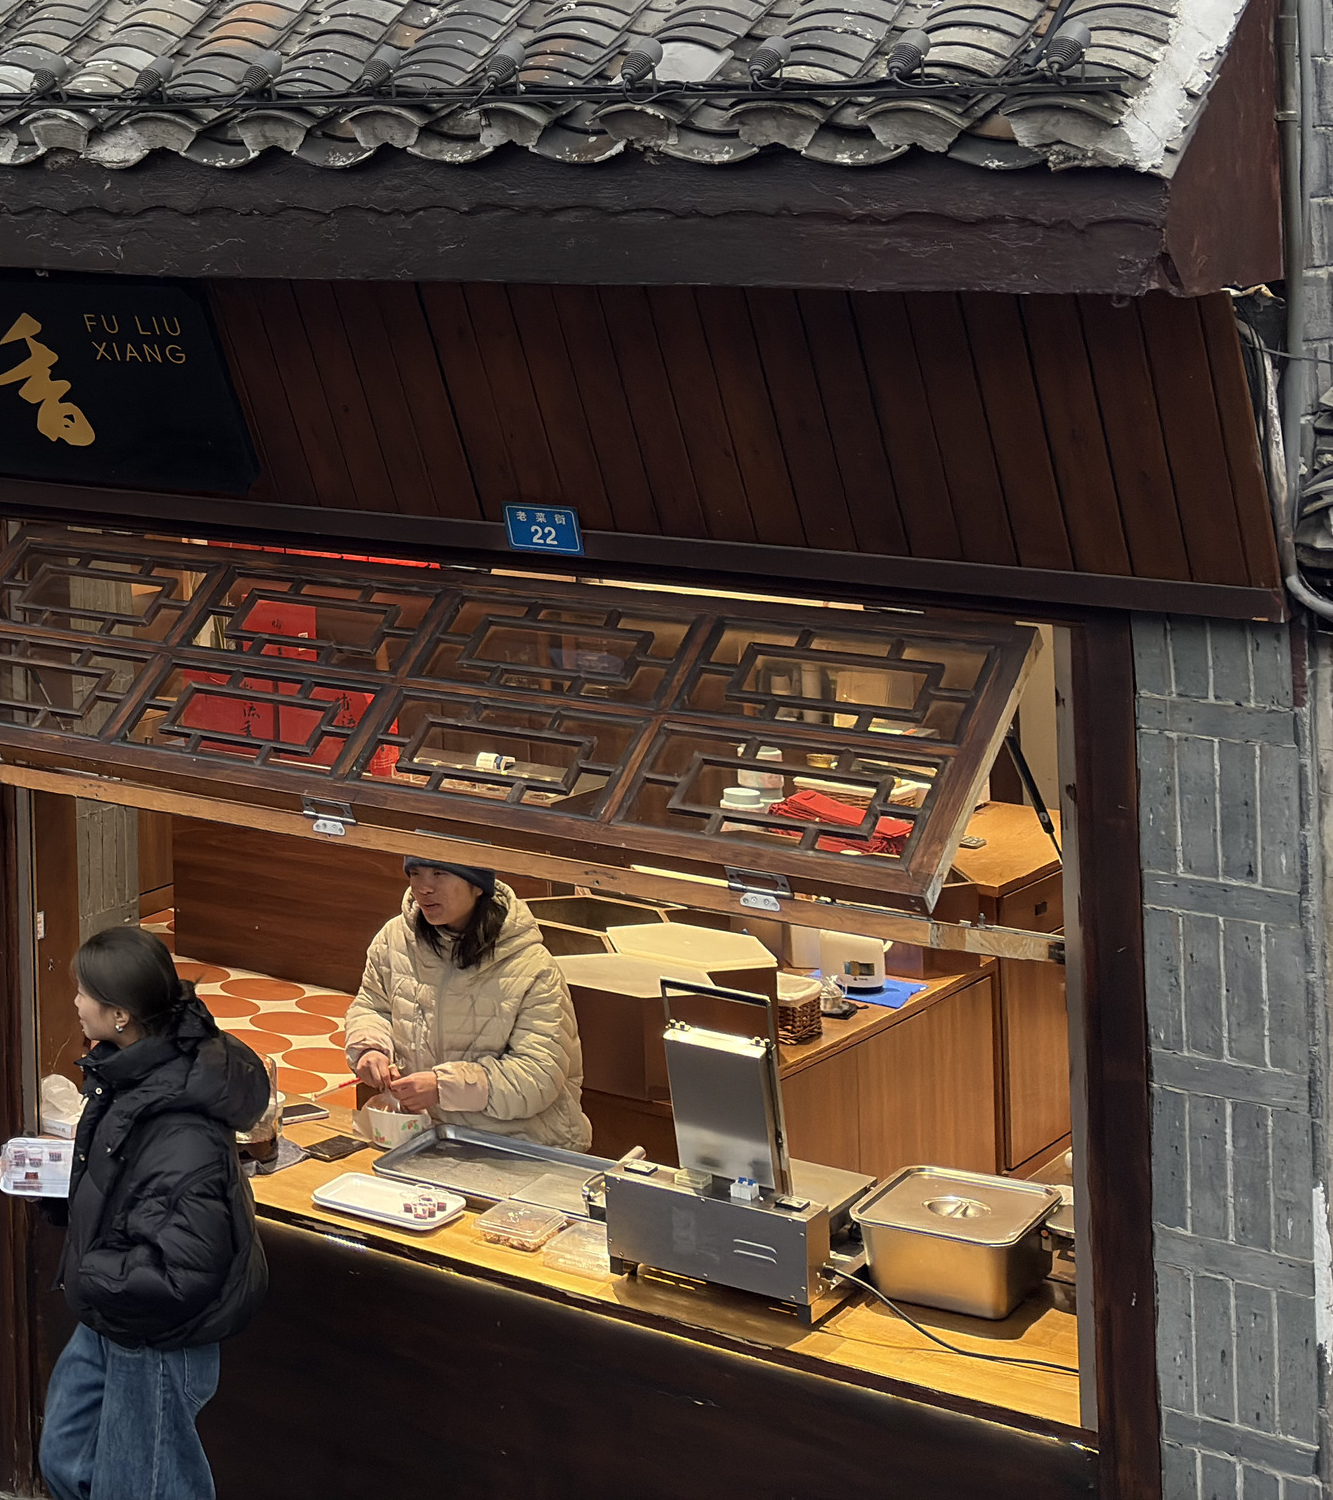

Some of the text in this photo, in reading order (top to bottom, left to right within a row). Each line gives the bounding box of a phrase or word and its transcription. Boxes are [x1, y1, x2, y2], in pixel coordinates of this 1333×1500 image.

[83, 313, 181, 336] FU LIU
[91, 341, 186, 364] XIANG
[530, 525, 558, 545] 22
